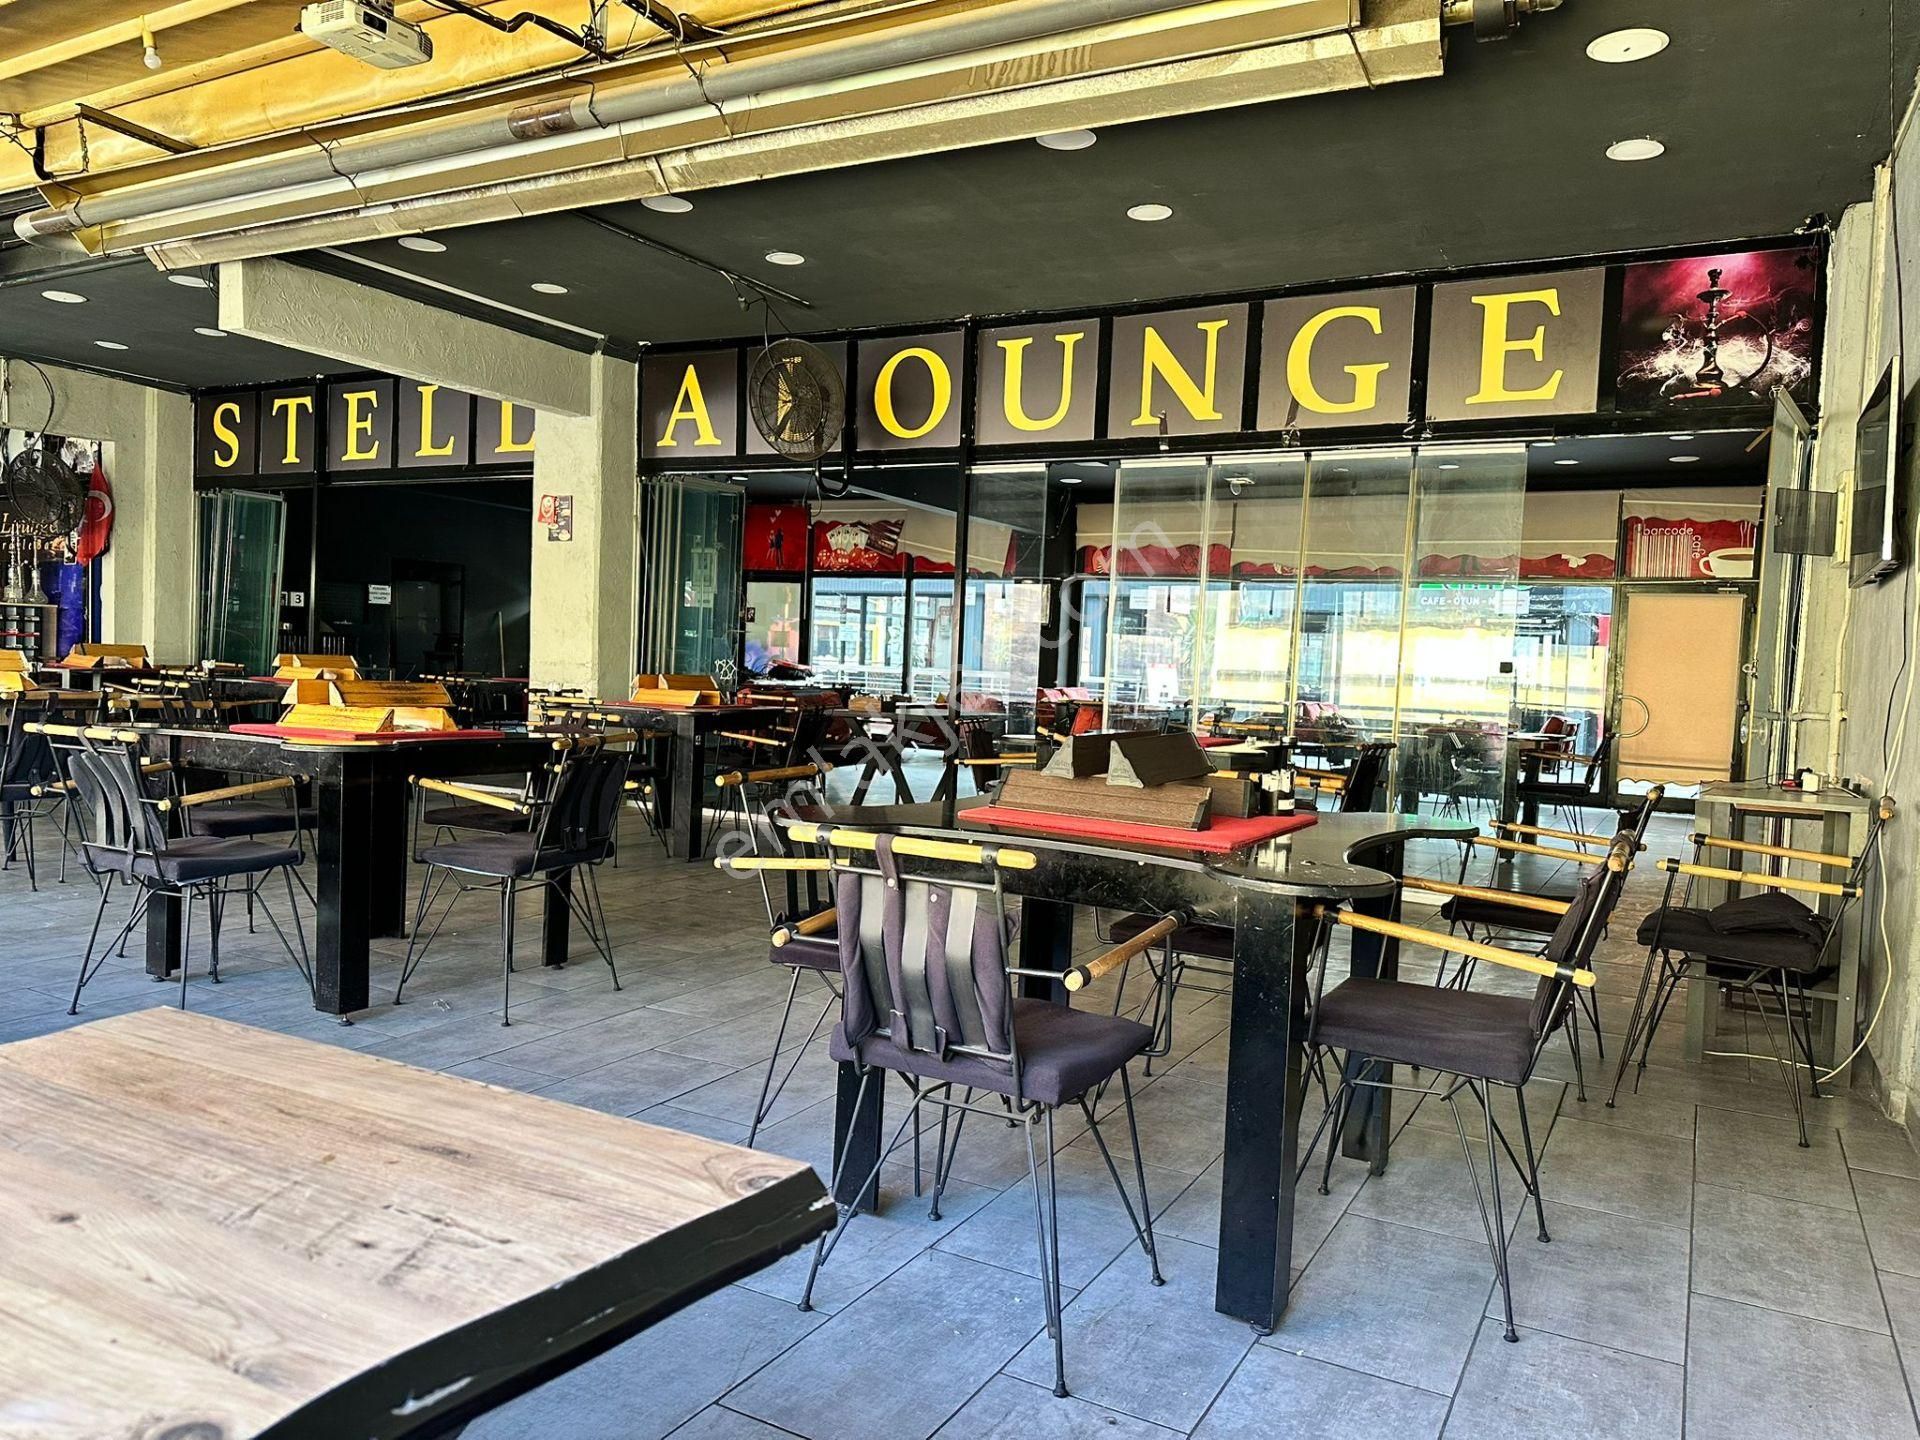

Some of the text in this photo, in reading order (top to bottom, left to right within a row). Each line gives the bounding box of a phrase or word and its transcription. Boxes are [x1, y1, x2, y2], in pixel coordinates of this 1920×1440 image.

[1642, 523, 1694, 536] barcode
[1691, 535, 1706, 559] cafe
[1420, 596, 1445, 606] CAFE
